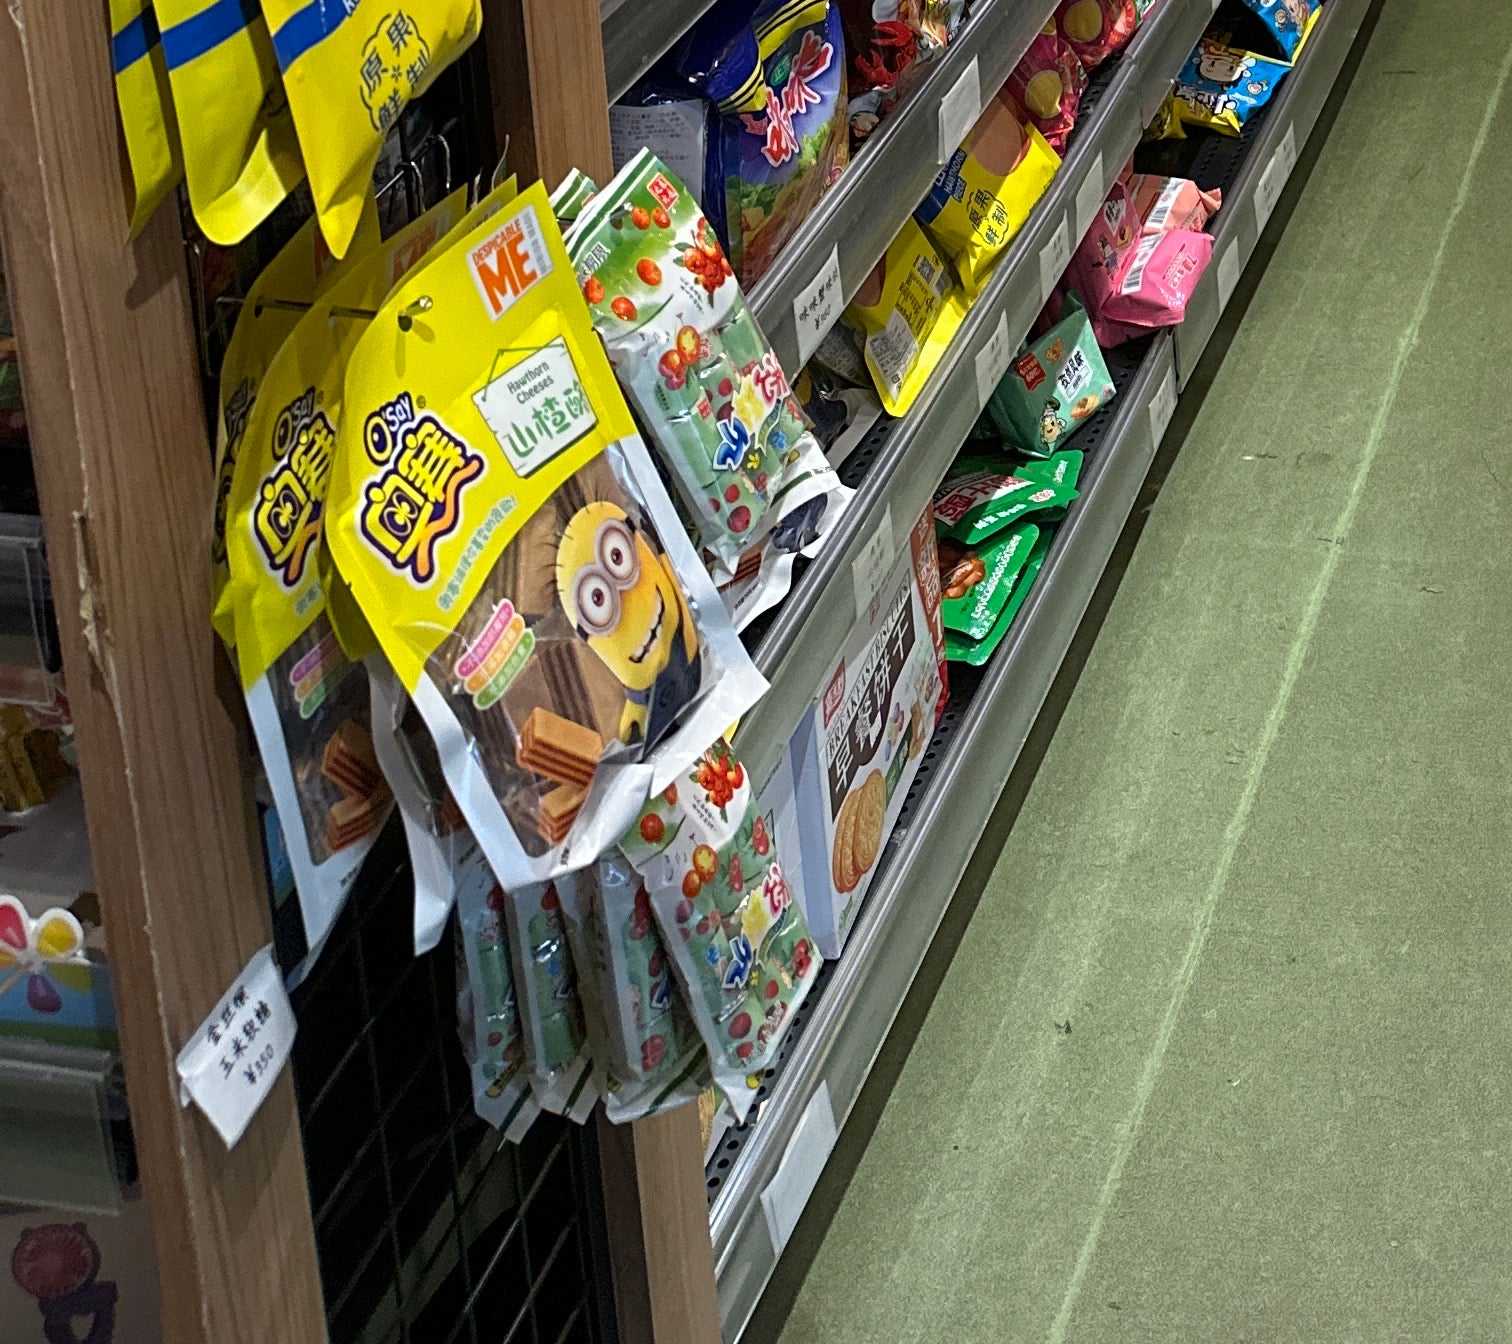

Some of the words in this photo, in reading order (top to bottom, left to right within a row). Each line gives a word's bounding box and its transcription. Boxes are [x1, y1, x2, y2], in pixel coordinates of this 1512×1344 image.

[942, 148, 967, 194] HAWTHORN
[471, 218, 522, 267] DESPICABLE
[476, 232, 539, 315] ME
[507, 361, 550, 395] Hawthorn
[516, 374, 556, 405] Cheeses
[825, 655, 876, 756] BREAKFAST
[831, 619, 917, 796] 早餐饼干
